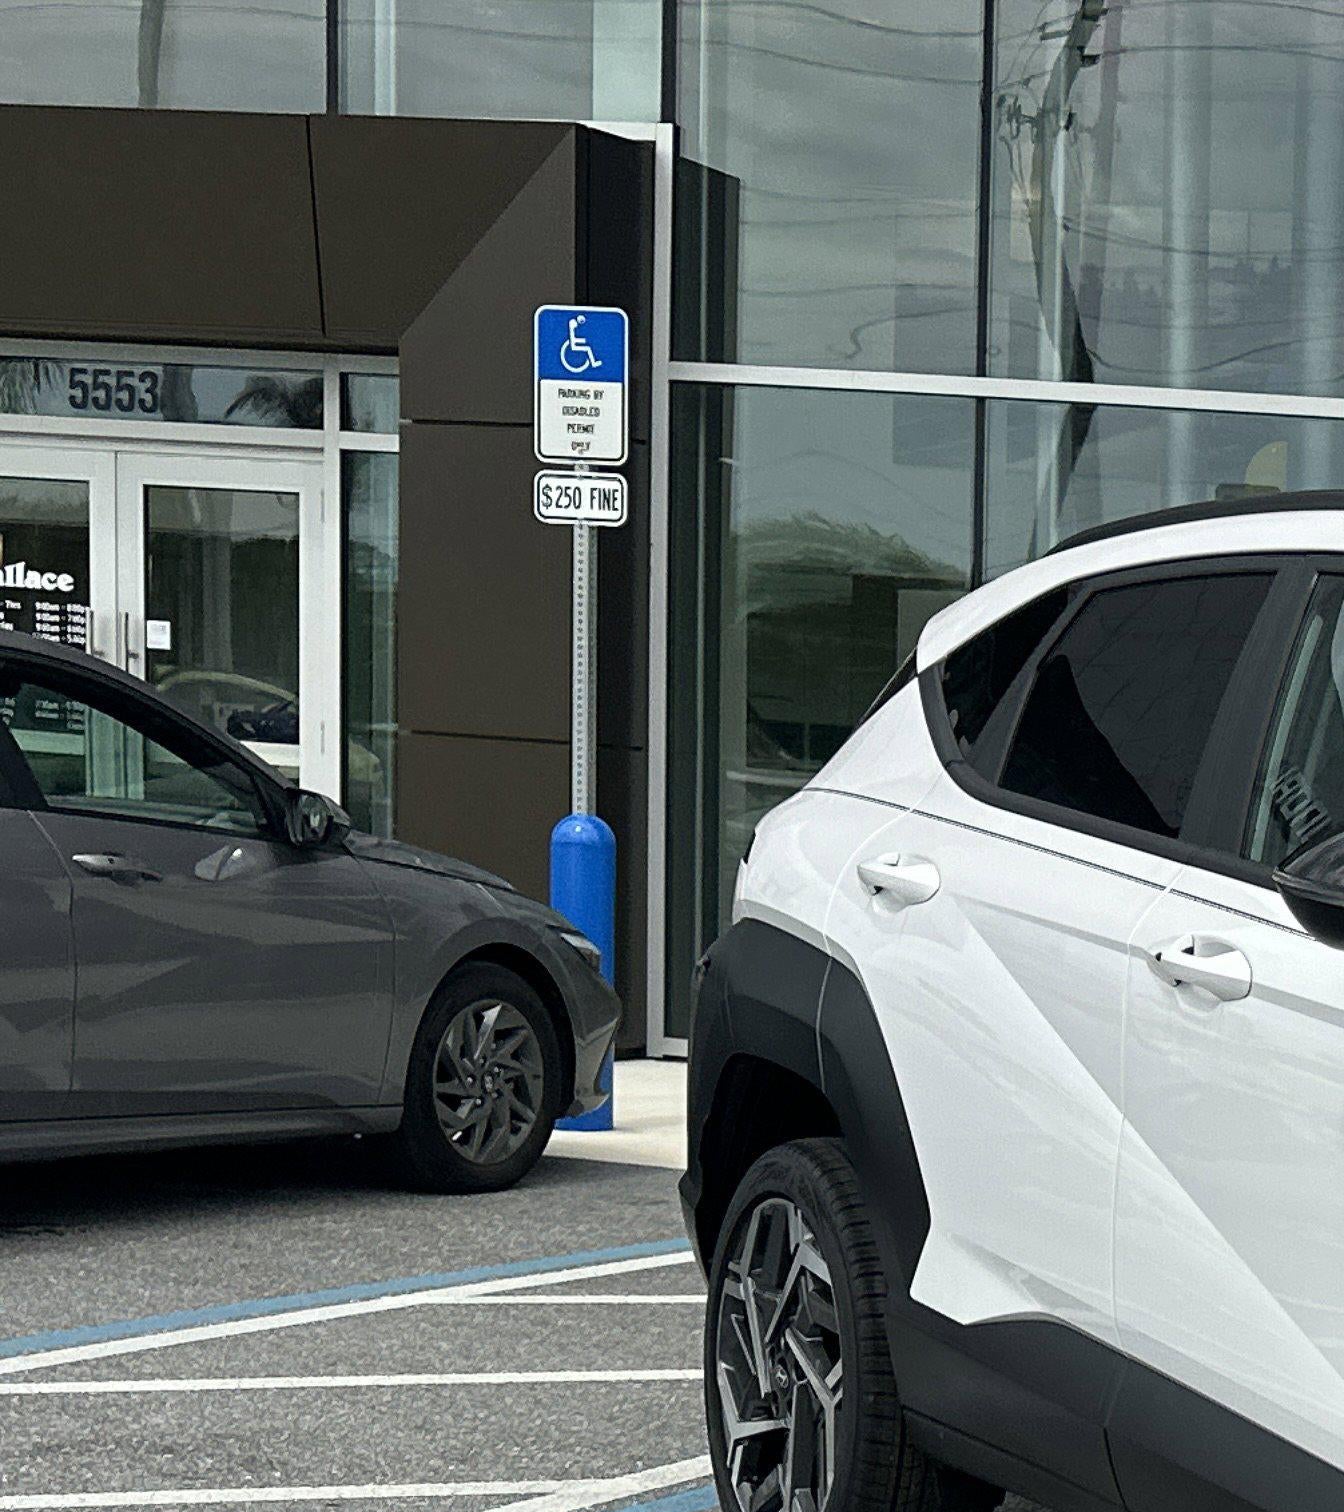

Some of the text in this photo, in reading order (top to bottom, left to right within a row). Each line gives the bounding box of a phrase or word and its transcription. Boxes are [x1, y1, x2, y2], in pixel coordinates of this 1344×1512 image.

[68, 367, 159, 413] 5553
[541, 483, 619, 511] $250 FINE
[0, 561, 75, 592] llace
